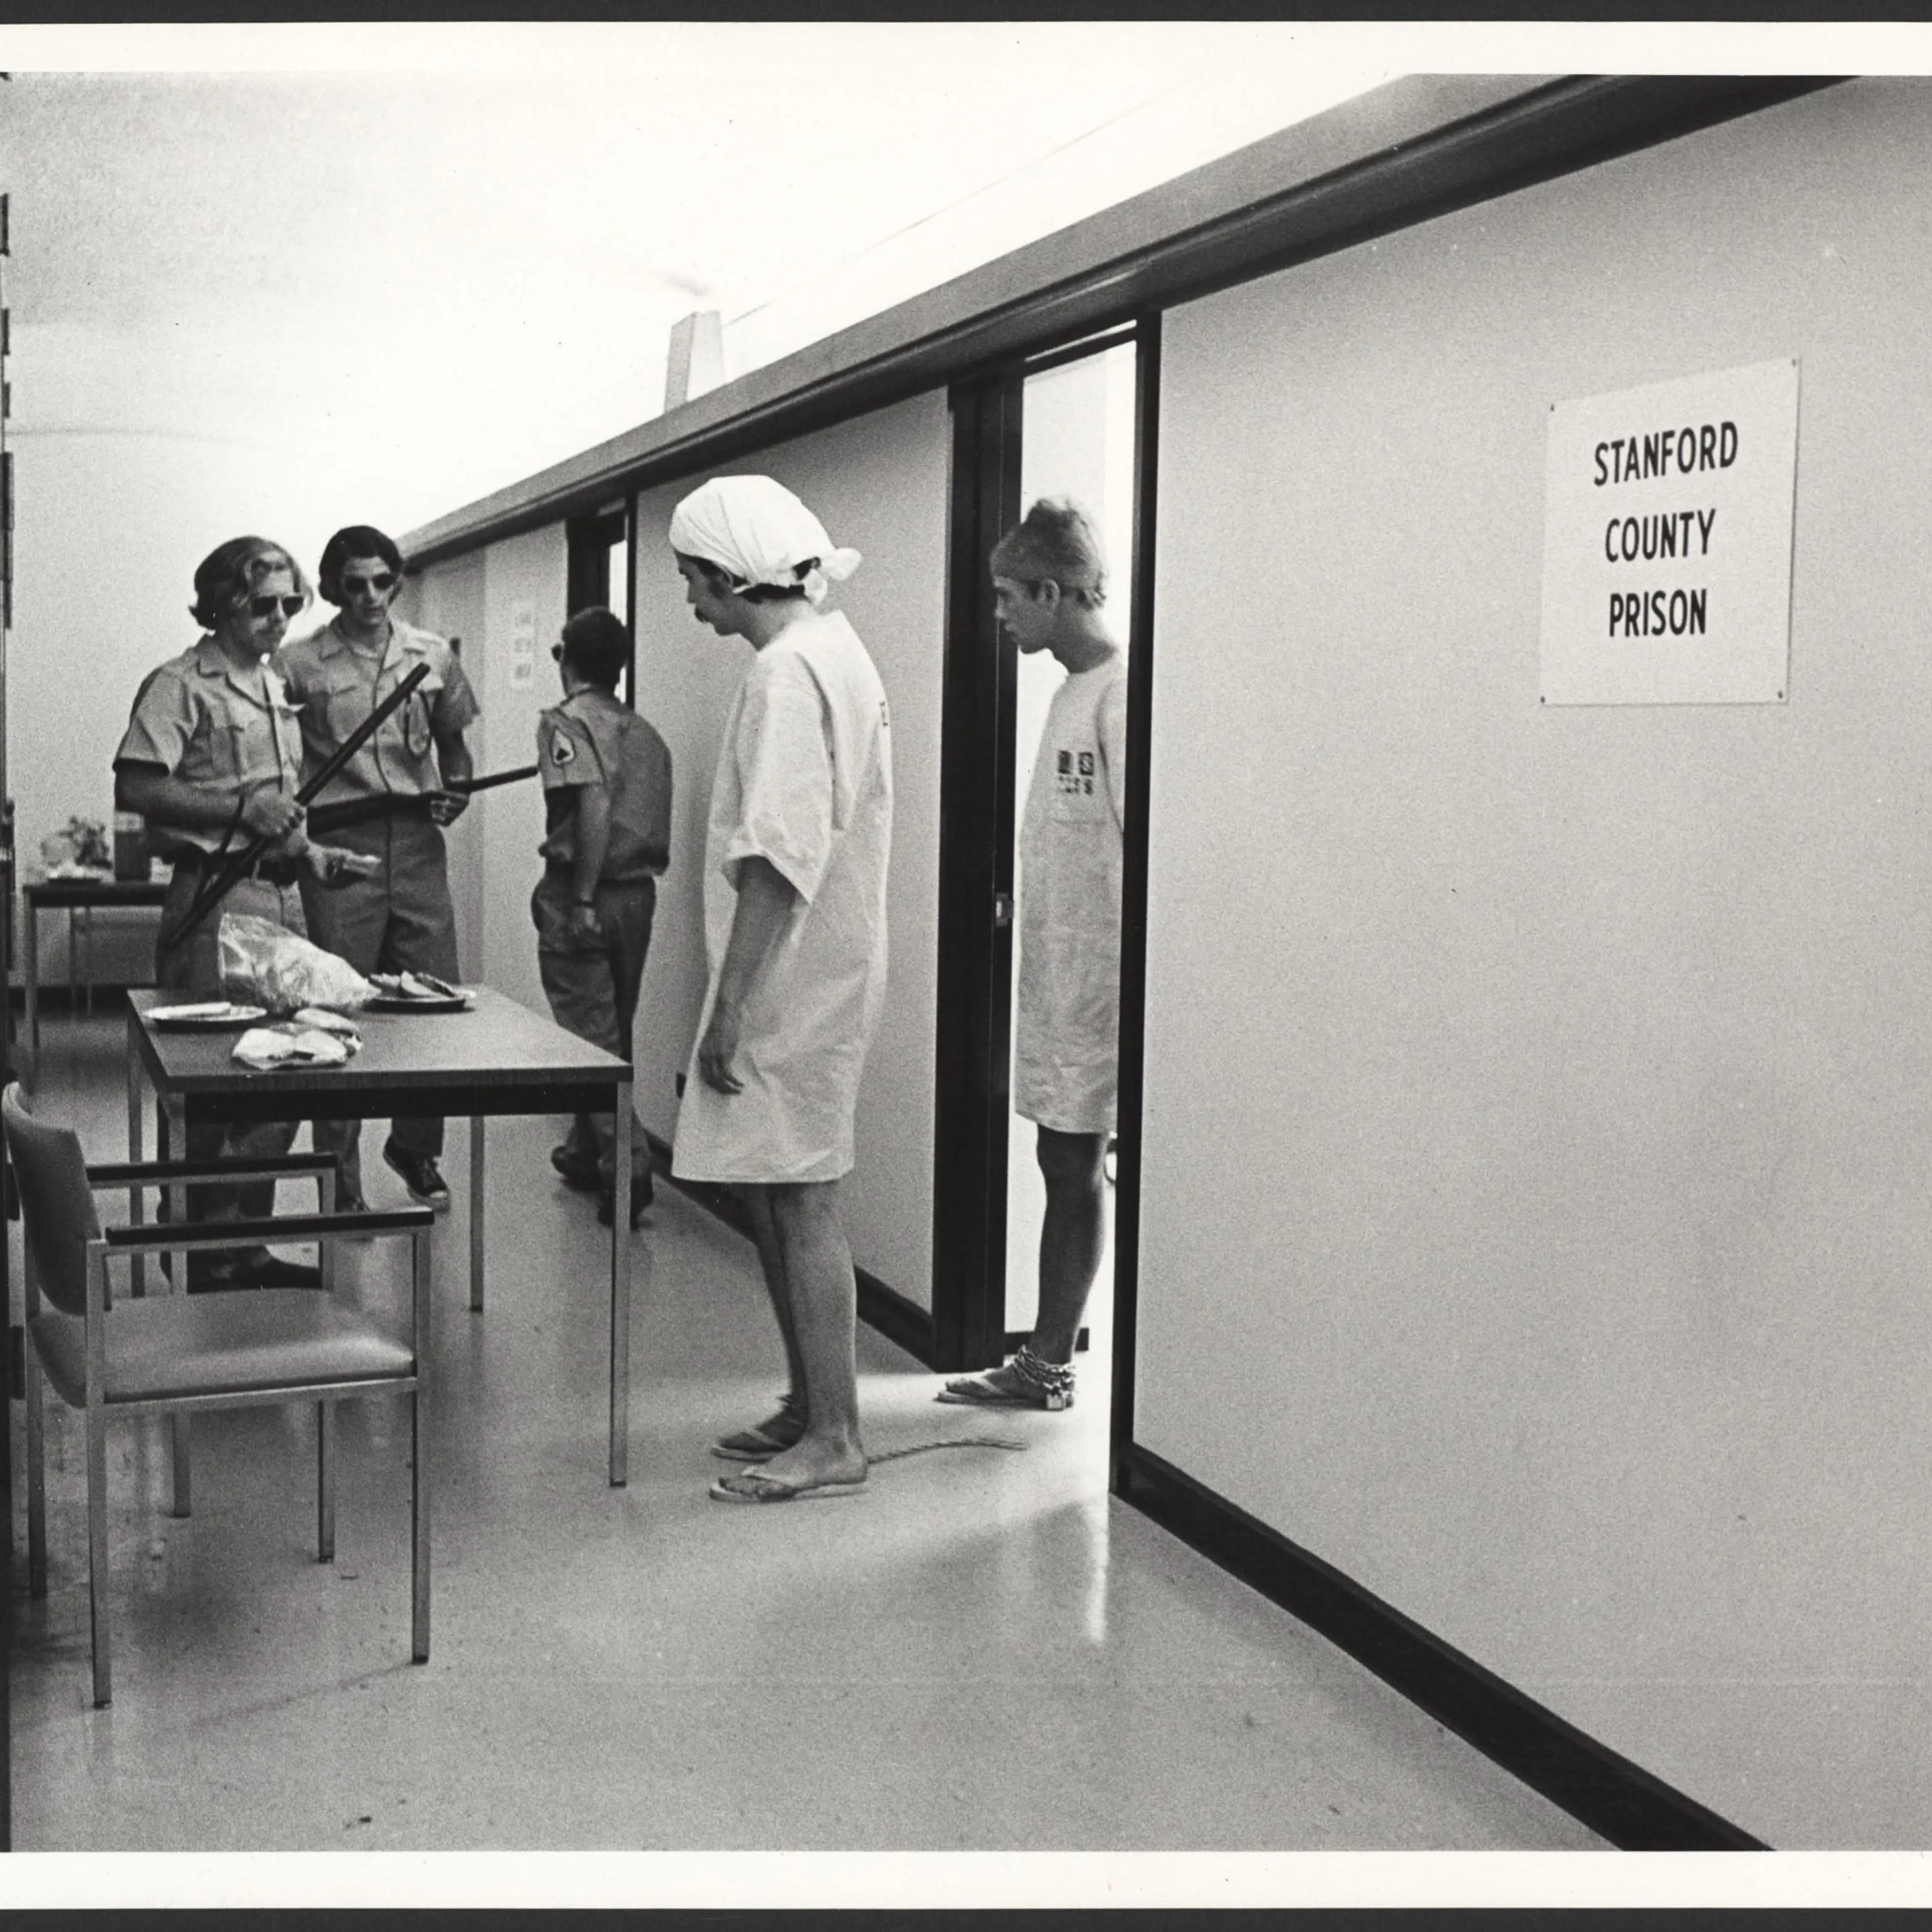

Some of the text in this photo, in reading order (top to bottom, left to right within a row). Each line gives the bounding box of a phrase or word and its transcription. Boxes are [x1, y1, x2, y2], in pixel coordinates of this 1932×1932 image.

[1594, 421, 1738, 487] STANFORD
[1605, 508, 1716, 562] COUNTY
[1609, 588, 1707, 637] PRISON
